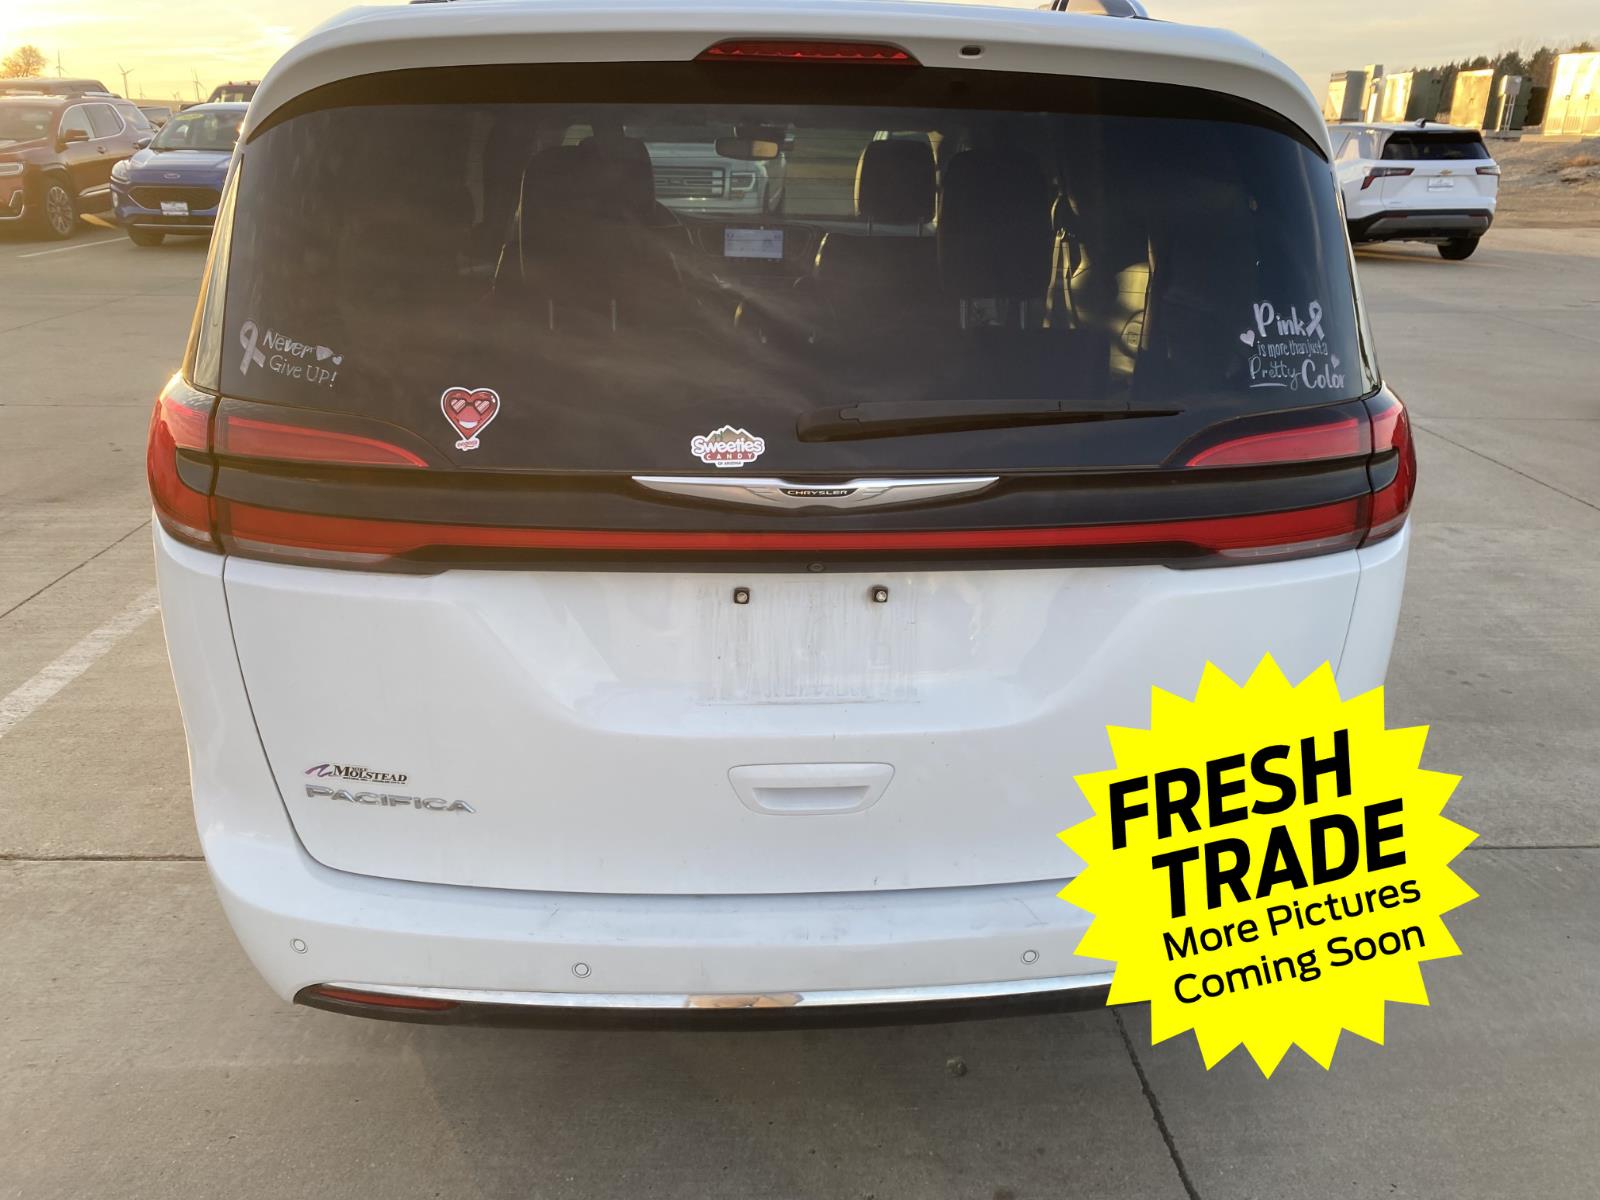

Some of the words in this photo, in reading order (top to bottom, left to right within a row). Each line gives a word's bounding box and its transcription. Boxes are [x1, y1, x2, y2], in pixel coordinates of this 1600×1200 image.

[1253, 302, 1307, 337] Pink
[262, 329, 315, 358] Never
[1257, 341, 1267, 357] is
[1267, 342, 1289, 358] more
[1290, 340, 1306, 356] than
[1306, 340, 1321, 357] just
[269, 354, 302, 379] Give
[1248, 354, 1302, 391] Pretty
[1301, 359, 1345, 389] Color
[692, 437, 763, 455] Sweeties
[706, 452, 753, 460] CANDY
[305, 784, 476, 814] PACIFICA
